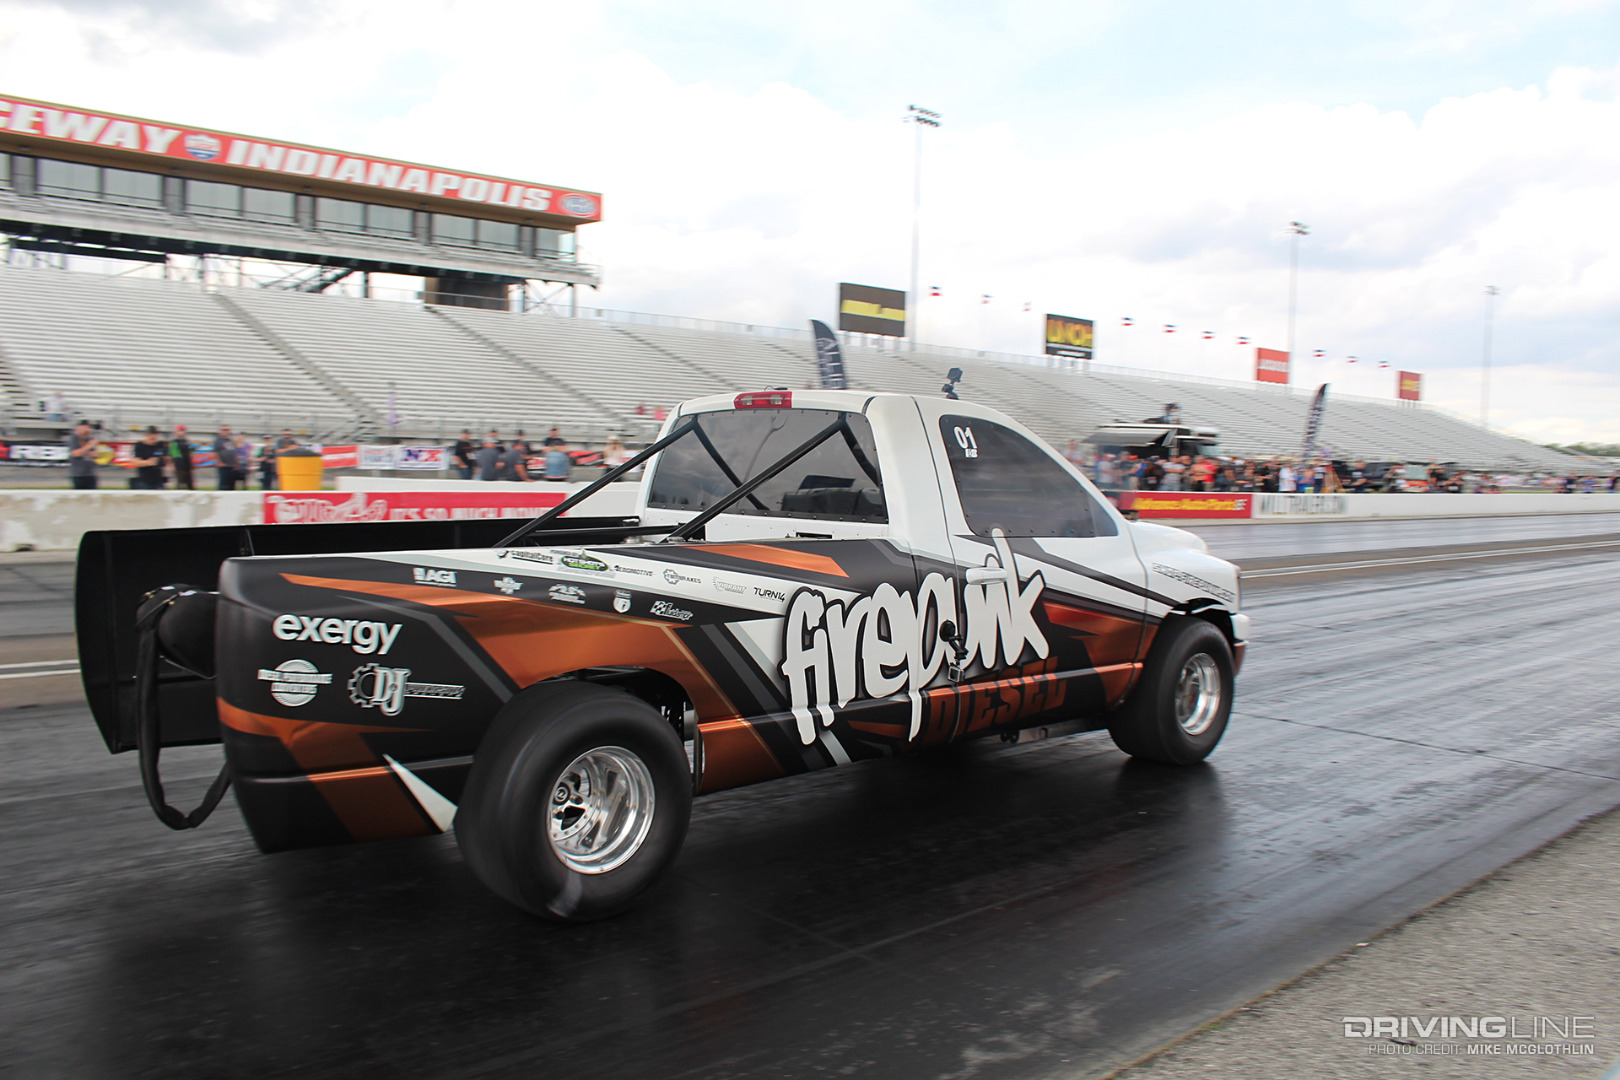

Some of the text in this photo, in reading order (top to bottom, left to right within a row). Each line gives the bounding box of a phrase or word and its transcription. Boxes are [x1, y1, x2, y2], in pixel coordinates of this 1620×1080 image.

[226, 139, 552, 212] INDIANAPOLIS
[272, 614, 402, 655] exergy
[925, 656, 1068, 743] DIESEL
